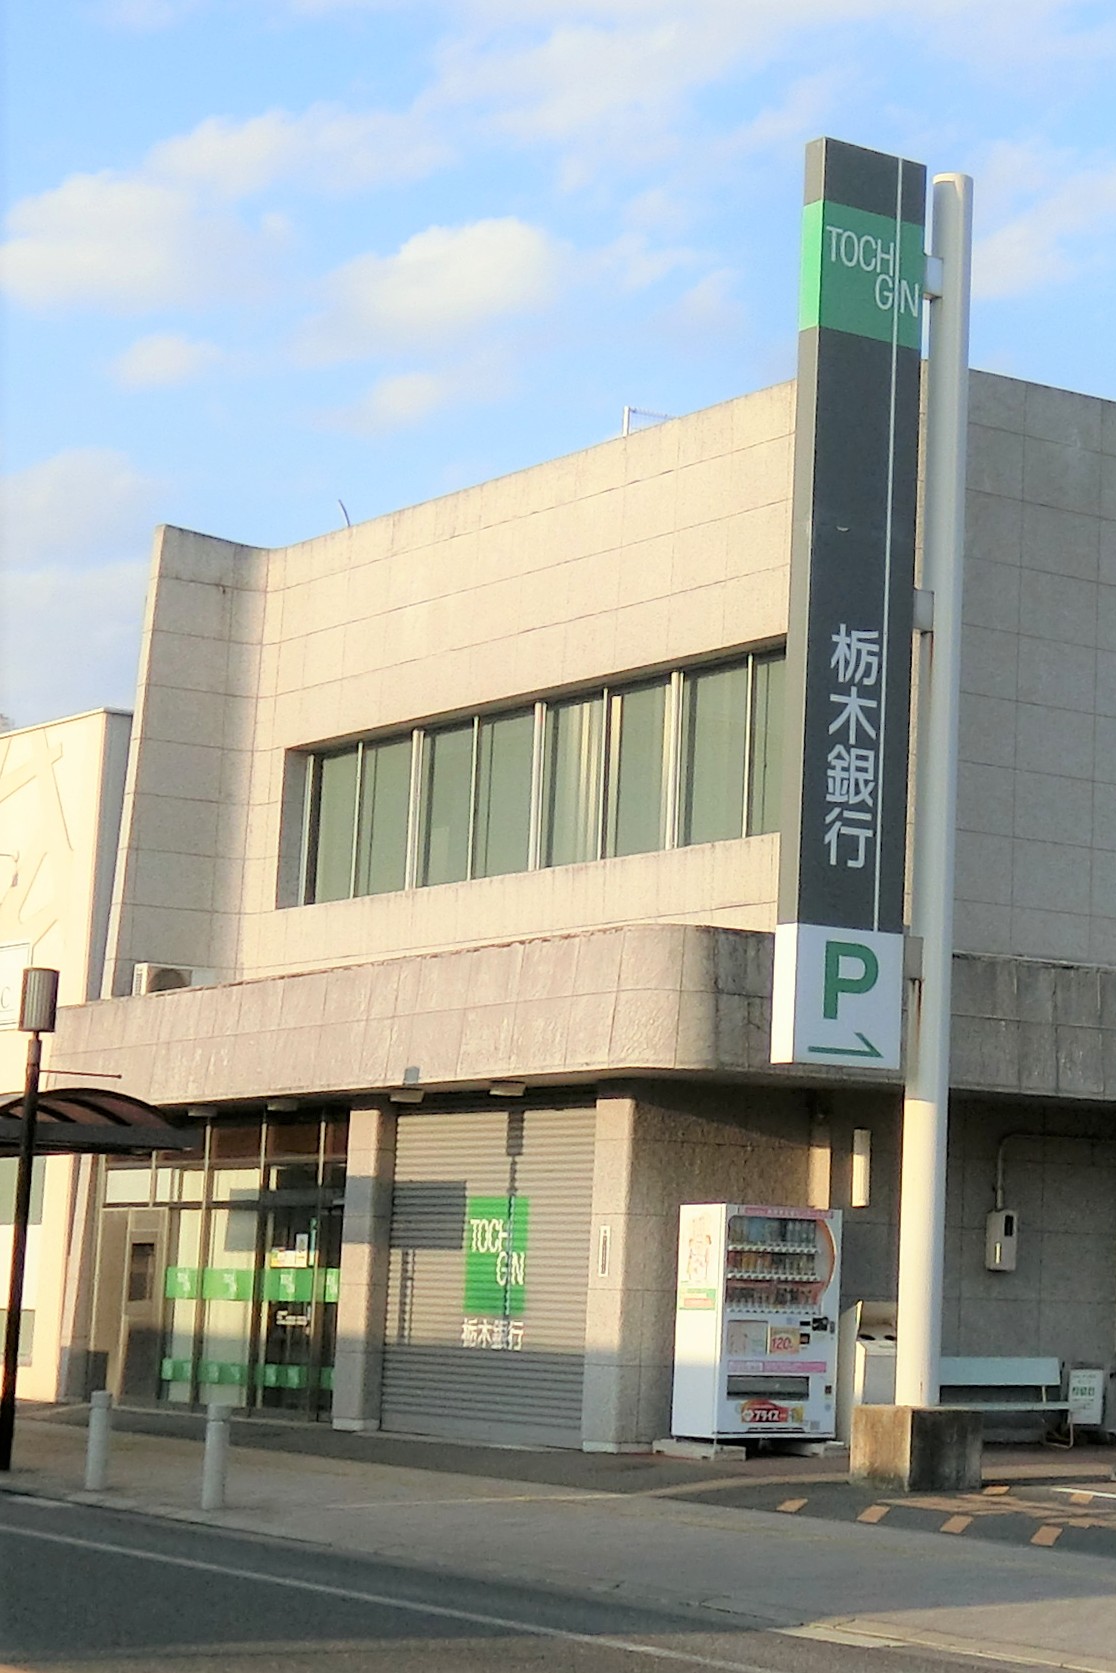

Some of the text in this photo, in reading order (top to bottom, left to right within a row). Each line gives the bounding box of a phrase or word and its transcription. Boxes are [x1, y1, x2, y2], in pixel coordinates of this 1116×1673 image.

[824, 623, 880, 868] 栃木銀行
[823, 940, 879, 1020] P
